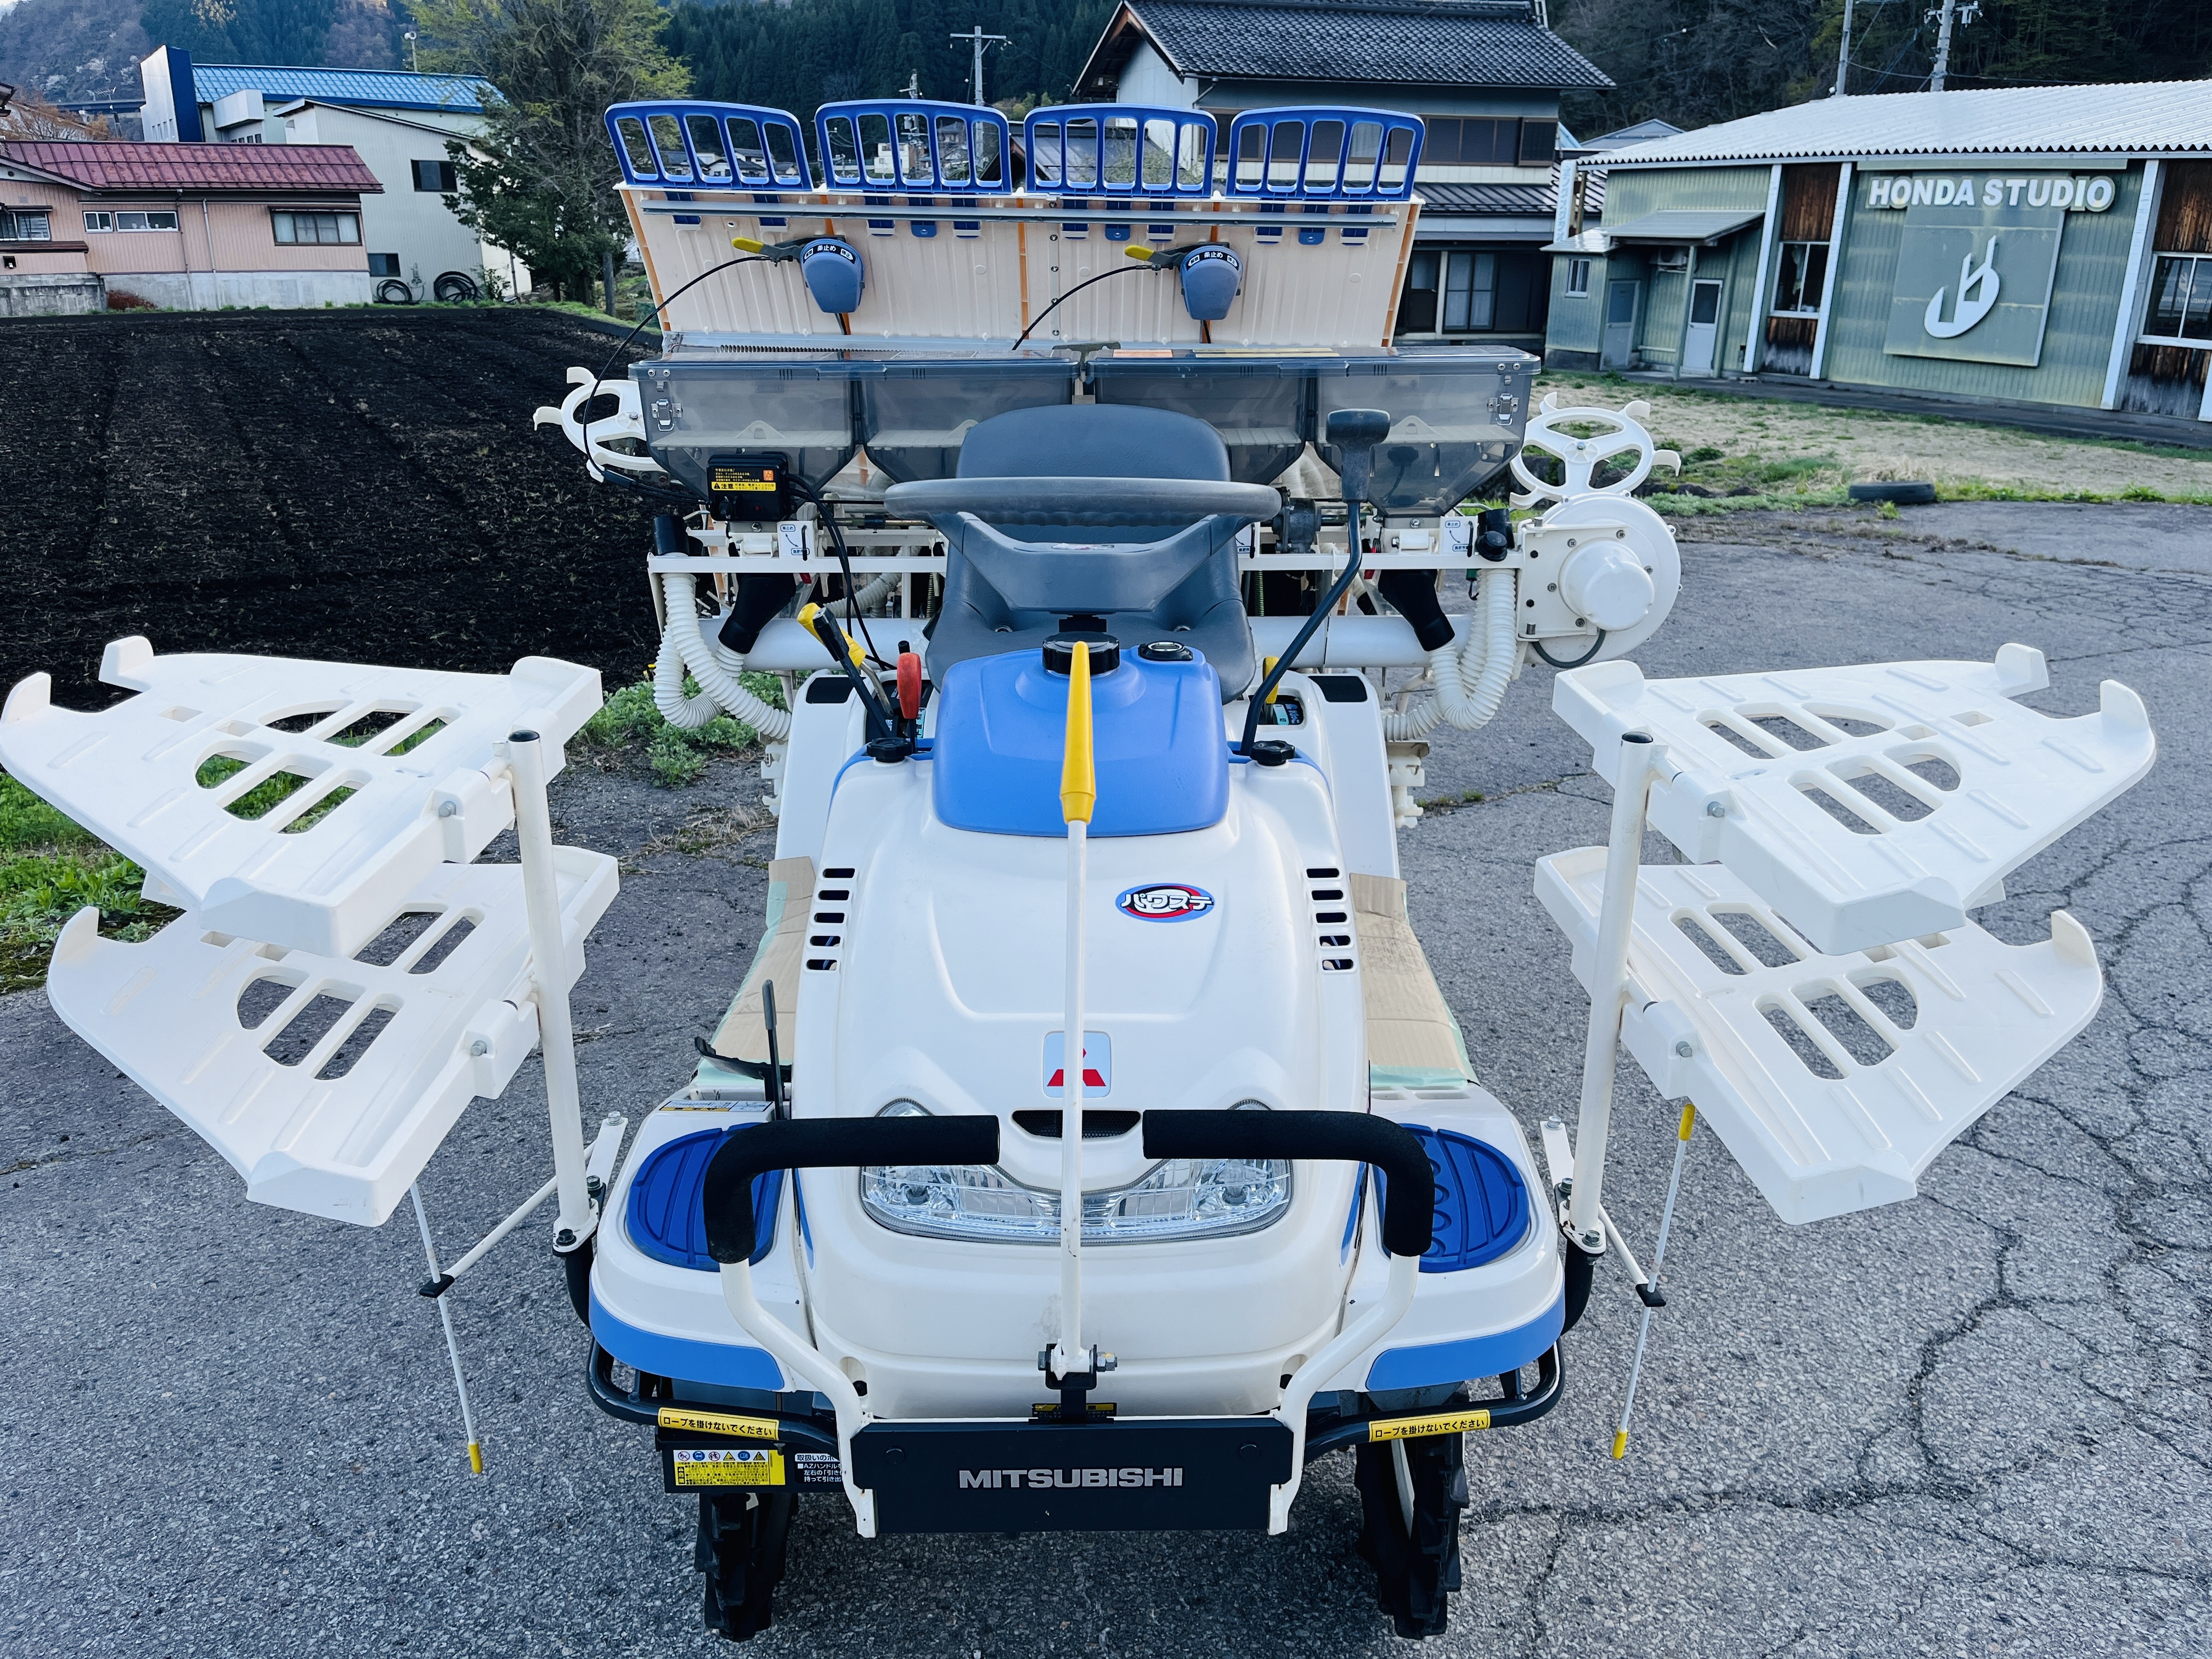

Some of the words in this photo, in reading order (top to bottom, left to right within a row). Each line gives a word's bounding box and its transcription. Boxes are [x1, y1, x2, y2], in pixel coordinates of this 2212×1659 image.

[1868, 178, 1975, 206] HONDA
[1982, 178, 2113, 208] STUDIO
[1120, 893, 1214, 911] パワステ
[663, 1417, 772, 1436] ロープを掛けないでください
[1375, 1419, 1485, 1438] ロープを掛けないでください
[959, 1468, 1183, 1488] MITSUBISHI
